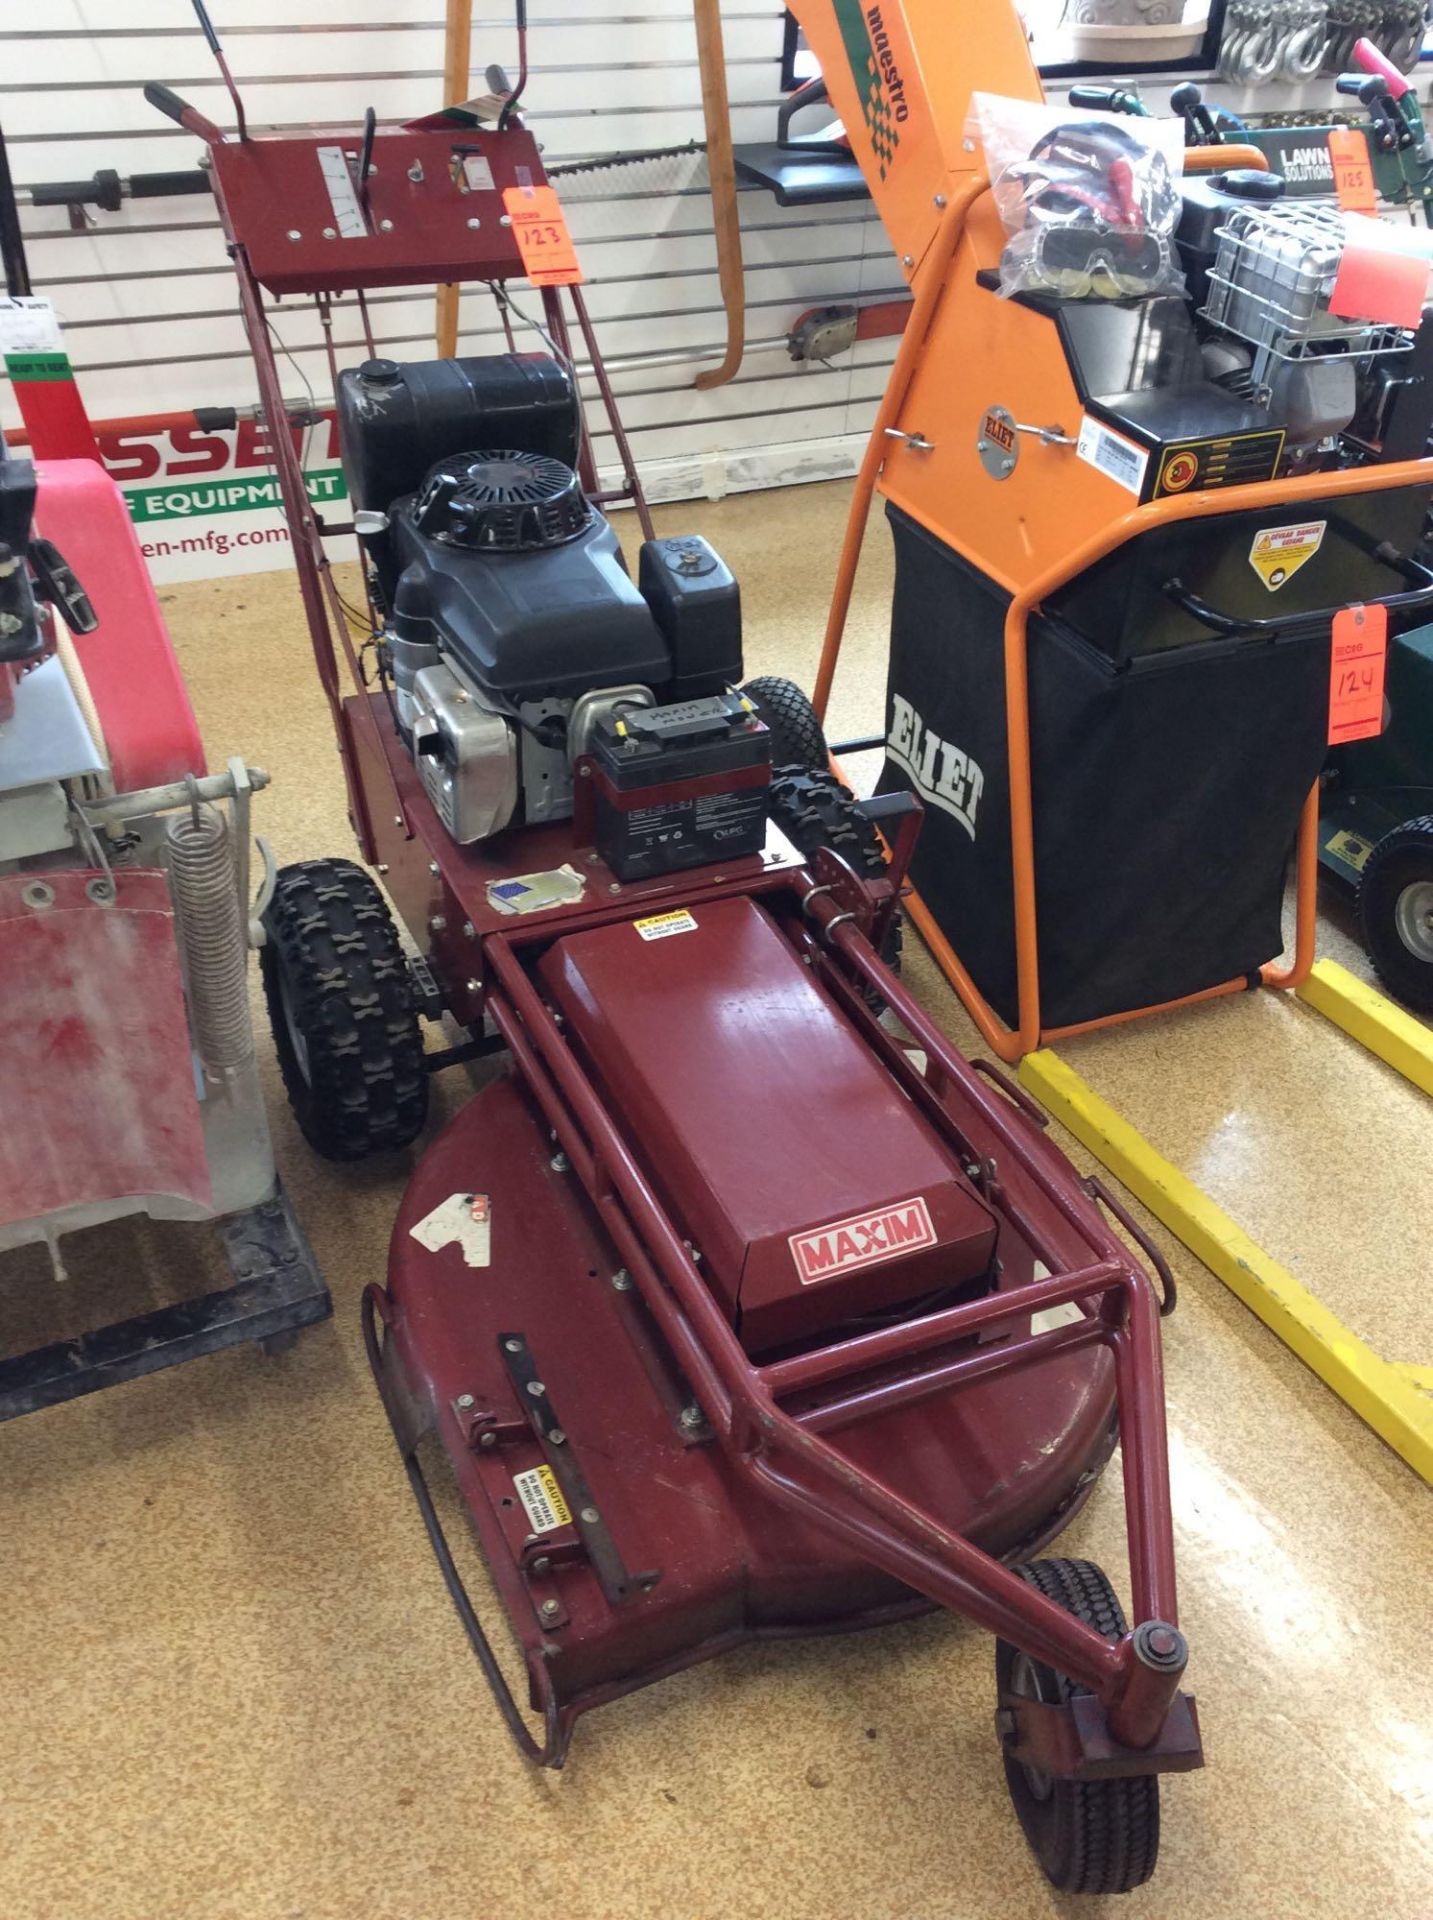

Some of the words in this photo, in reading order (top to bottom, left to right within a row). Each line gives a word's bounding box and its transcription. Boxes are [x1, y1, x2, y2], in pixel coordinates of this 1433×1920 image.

[867, 6, 908, 122] maestro
[1281, 147, 1330, 167] LAWN
[1284, 164, 1334, 182] SOLUTIONS
[1343, 171, 1363, 188] 125
[524, 227, 561, 245] 123
[145, 476, 339, 515] EQUIPMNT
[140, 527, 289, 558] en-mfg.com
[1338, 667, 1373, 697] 124
[887, 693, 984, 825] ELIET
[800, 1209, 923, 1272] MAXIM
[528, 1474, 537, 1484] DO
[532, 1484, 543, 1497] NOT
[520, 1478, 536, 1506] WITHOUT
[531, 1505, 546, 1528] GUARD
[538, 1498, 555, 1525] OPERATE
[545, 1479, 569, 1522] CAUTION
